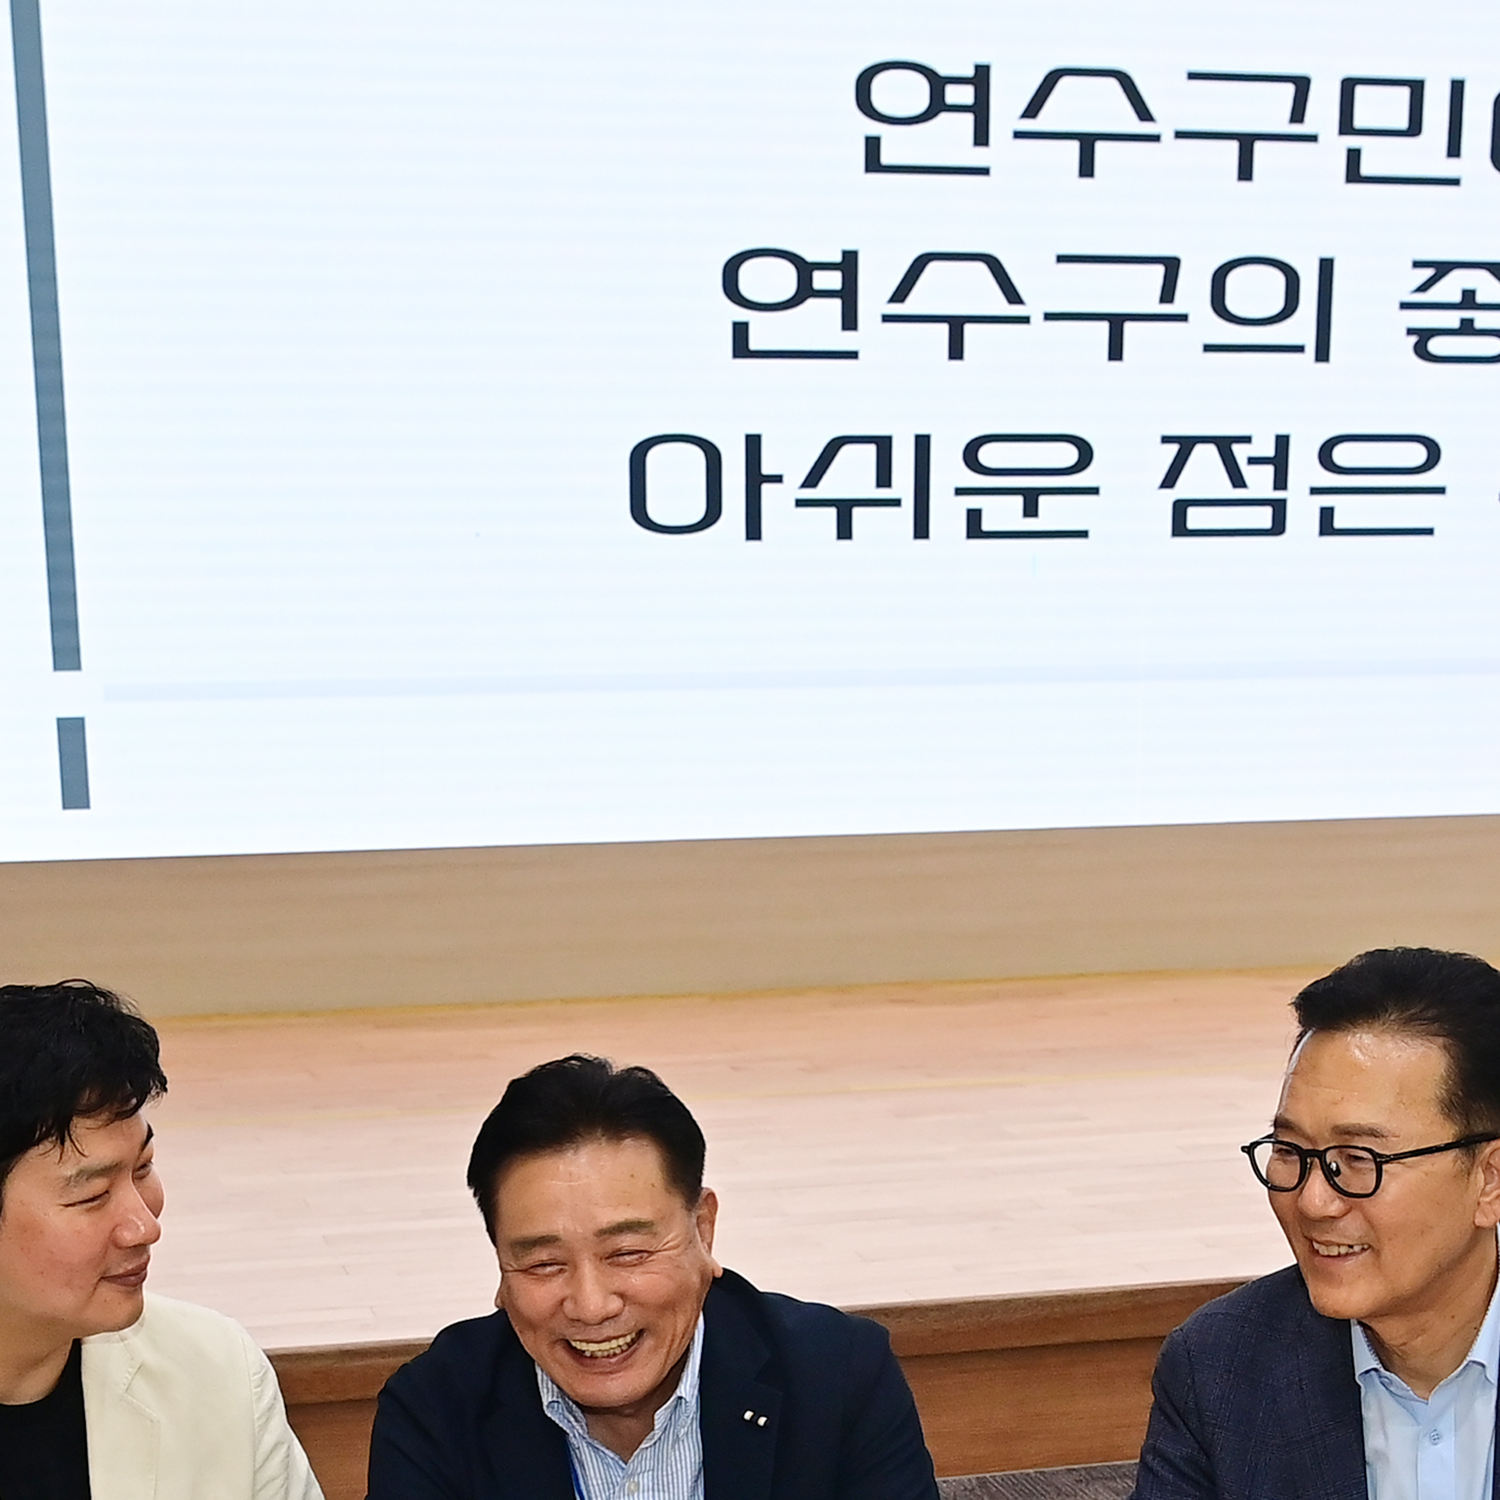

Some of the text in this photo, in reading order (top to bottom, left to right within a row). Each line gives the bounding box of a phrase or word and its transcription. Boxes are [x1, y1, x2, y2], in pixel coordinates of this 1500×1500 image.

[720, 247, 1333, 367] 연수구의
[628, 431, 1102, 541] 아쉬운
[1158, 433, 1447, 538] 점은
